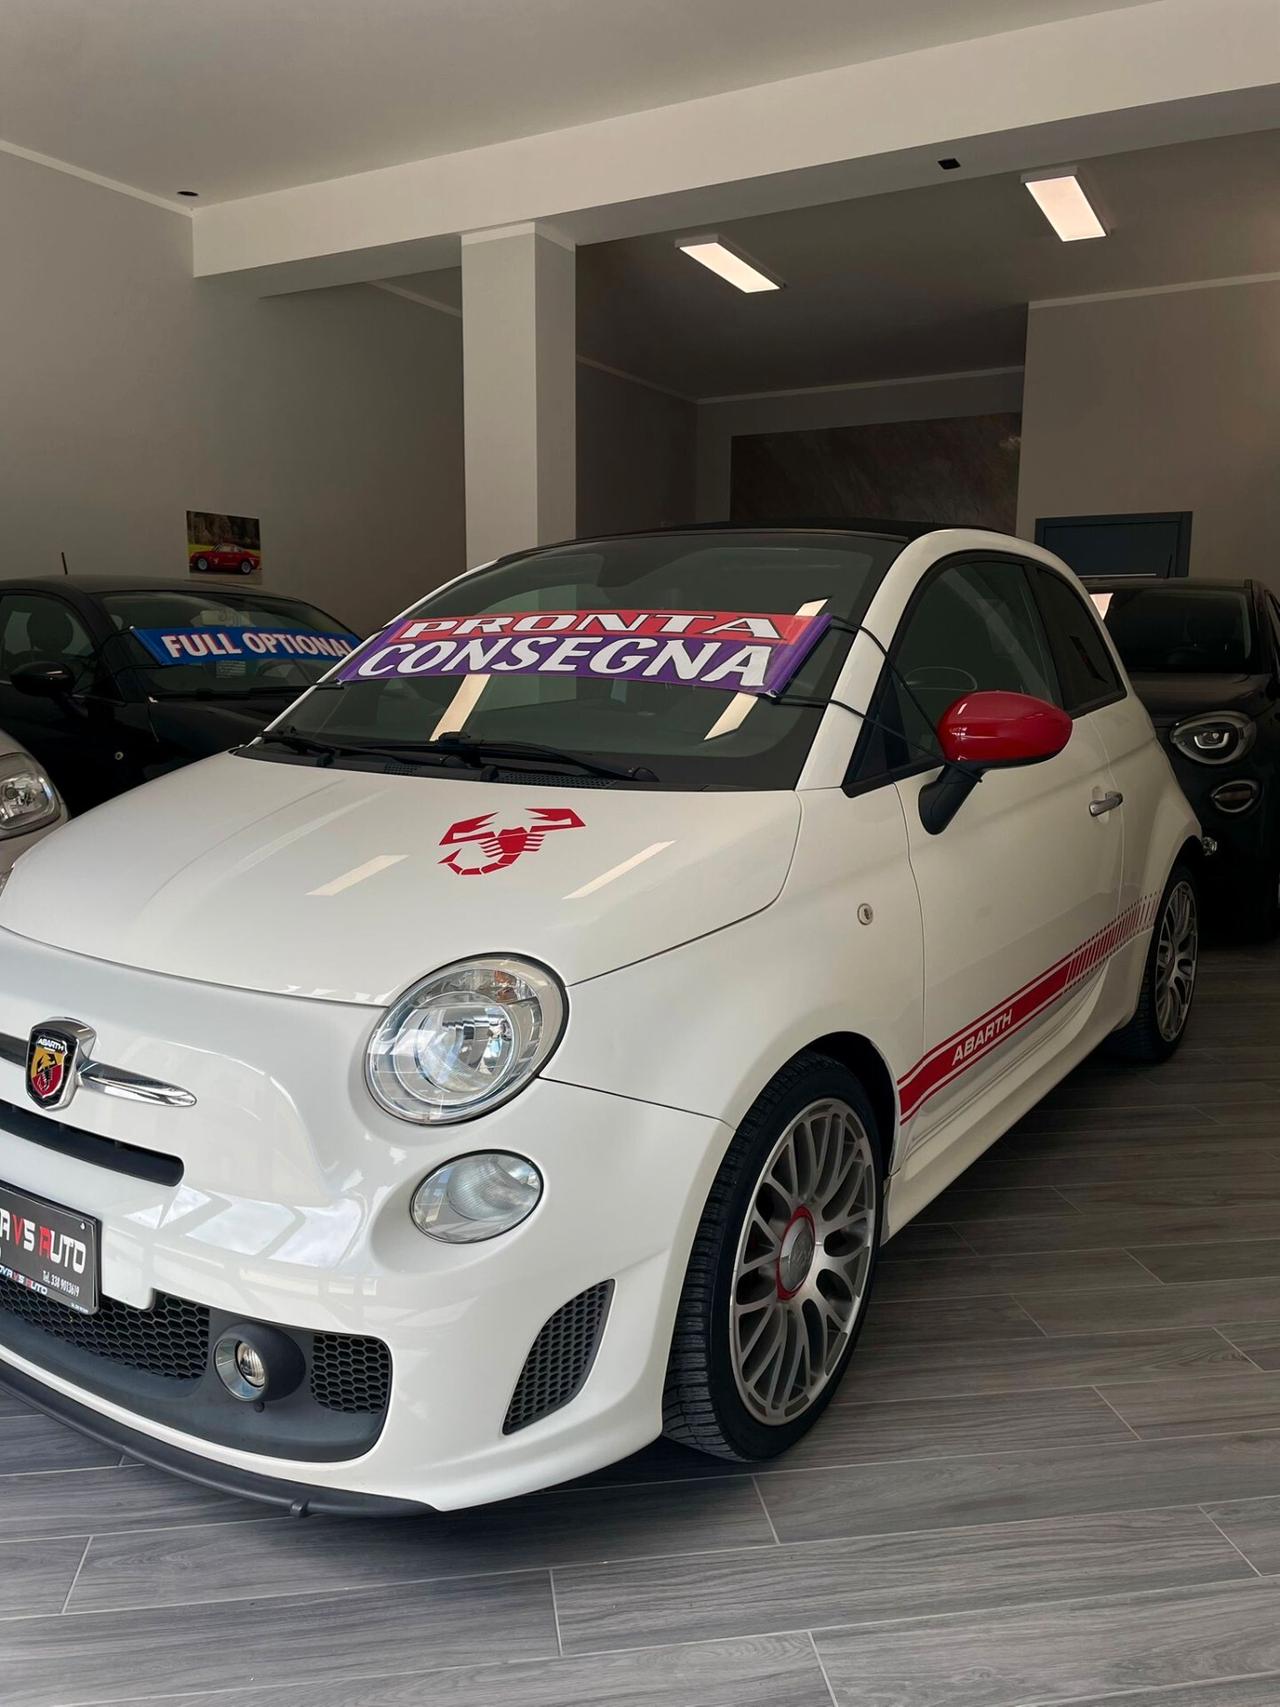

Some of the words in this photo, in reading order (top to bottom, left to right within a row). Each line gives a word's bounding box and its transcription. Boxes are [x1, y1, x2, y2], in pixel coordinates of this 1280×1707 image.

[399, 613, 781, 639] PRONTA
[160, 633, 242, 658] FULL
[357, 636, 772, 688] CONSEGNA
[37, 1038, 64, 1051] ABARTH
[951, 1009, 1013, 1066] ABARTH
[39, 1226, 86, 1274] AUTO
